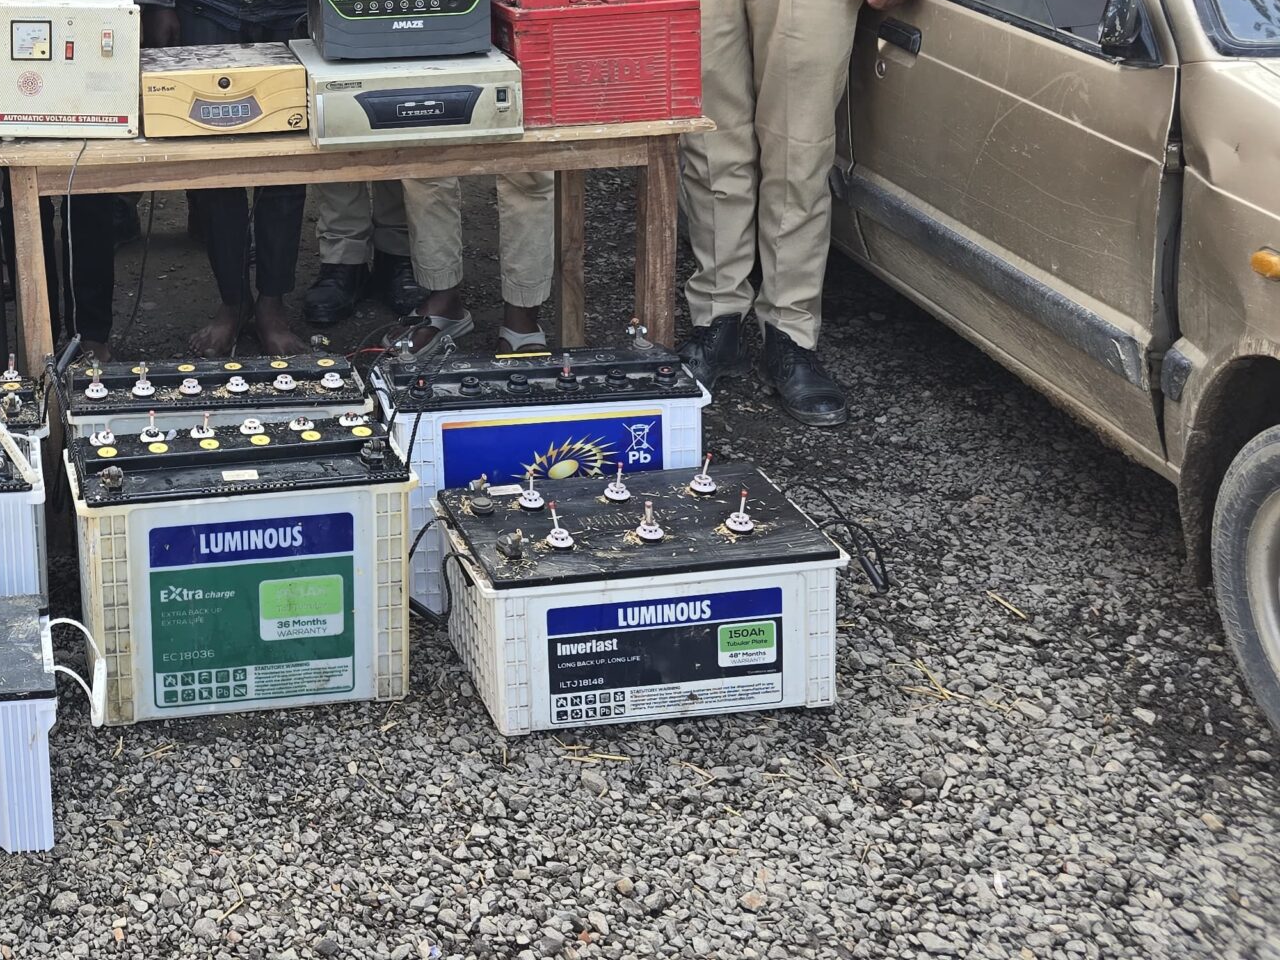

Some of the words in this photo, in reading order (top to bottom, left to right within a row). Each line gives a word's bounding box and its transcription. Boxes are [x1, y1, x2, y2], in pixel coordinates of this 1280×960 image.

[392, 20, 424, 29] AMAZE
[3, 114, 44, 122] AUTOMATIC
[628, 451, 651, 464] Pb
[199, 525, 303, 554] LUMINOUS
[205, 589, 236, 600] charge
[161, 610, 187, 618] EXTRA
[188, 608, 209, 616] BACK
[617, 600, 712, 627] LUMINOUS
[277, 621, 290, 629] 36
[292, 618, 327, 628] Months
[277, 627, 328, 638] WARRANTY
[728, 627, 765, 639] 150Ah
[556, 638, 618, 656] Inverlast
[557, 661, 575, 669] LONG
